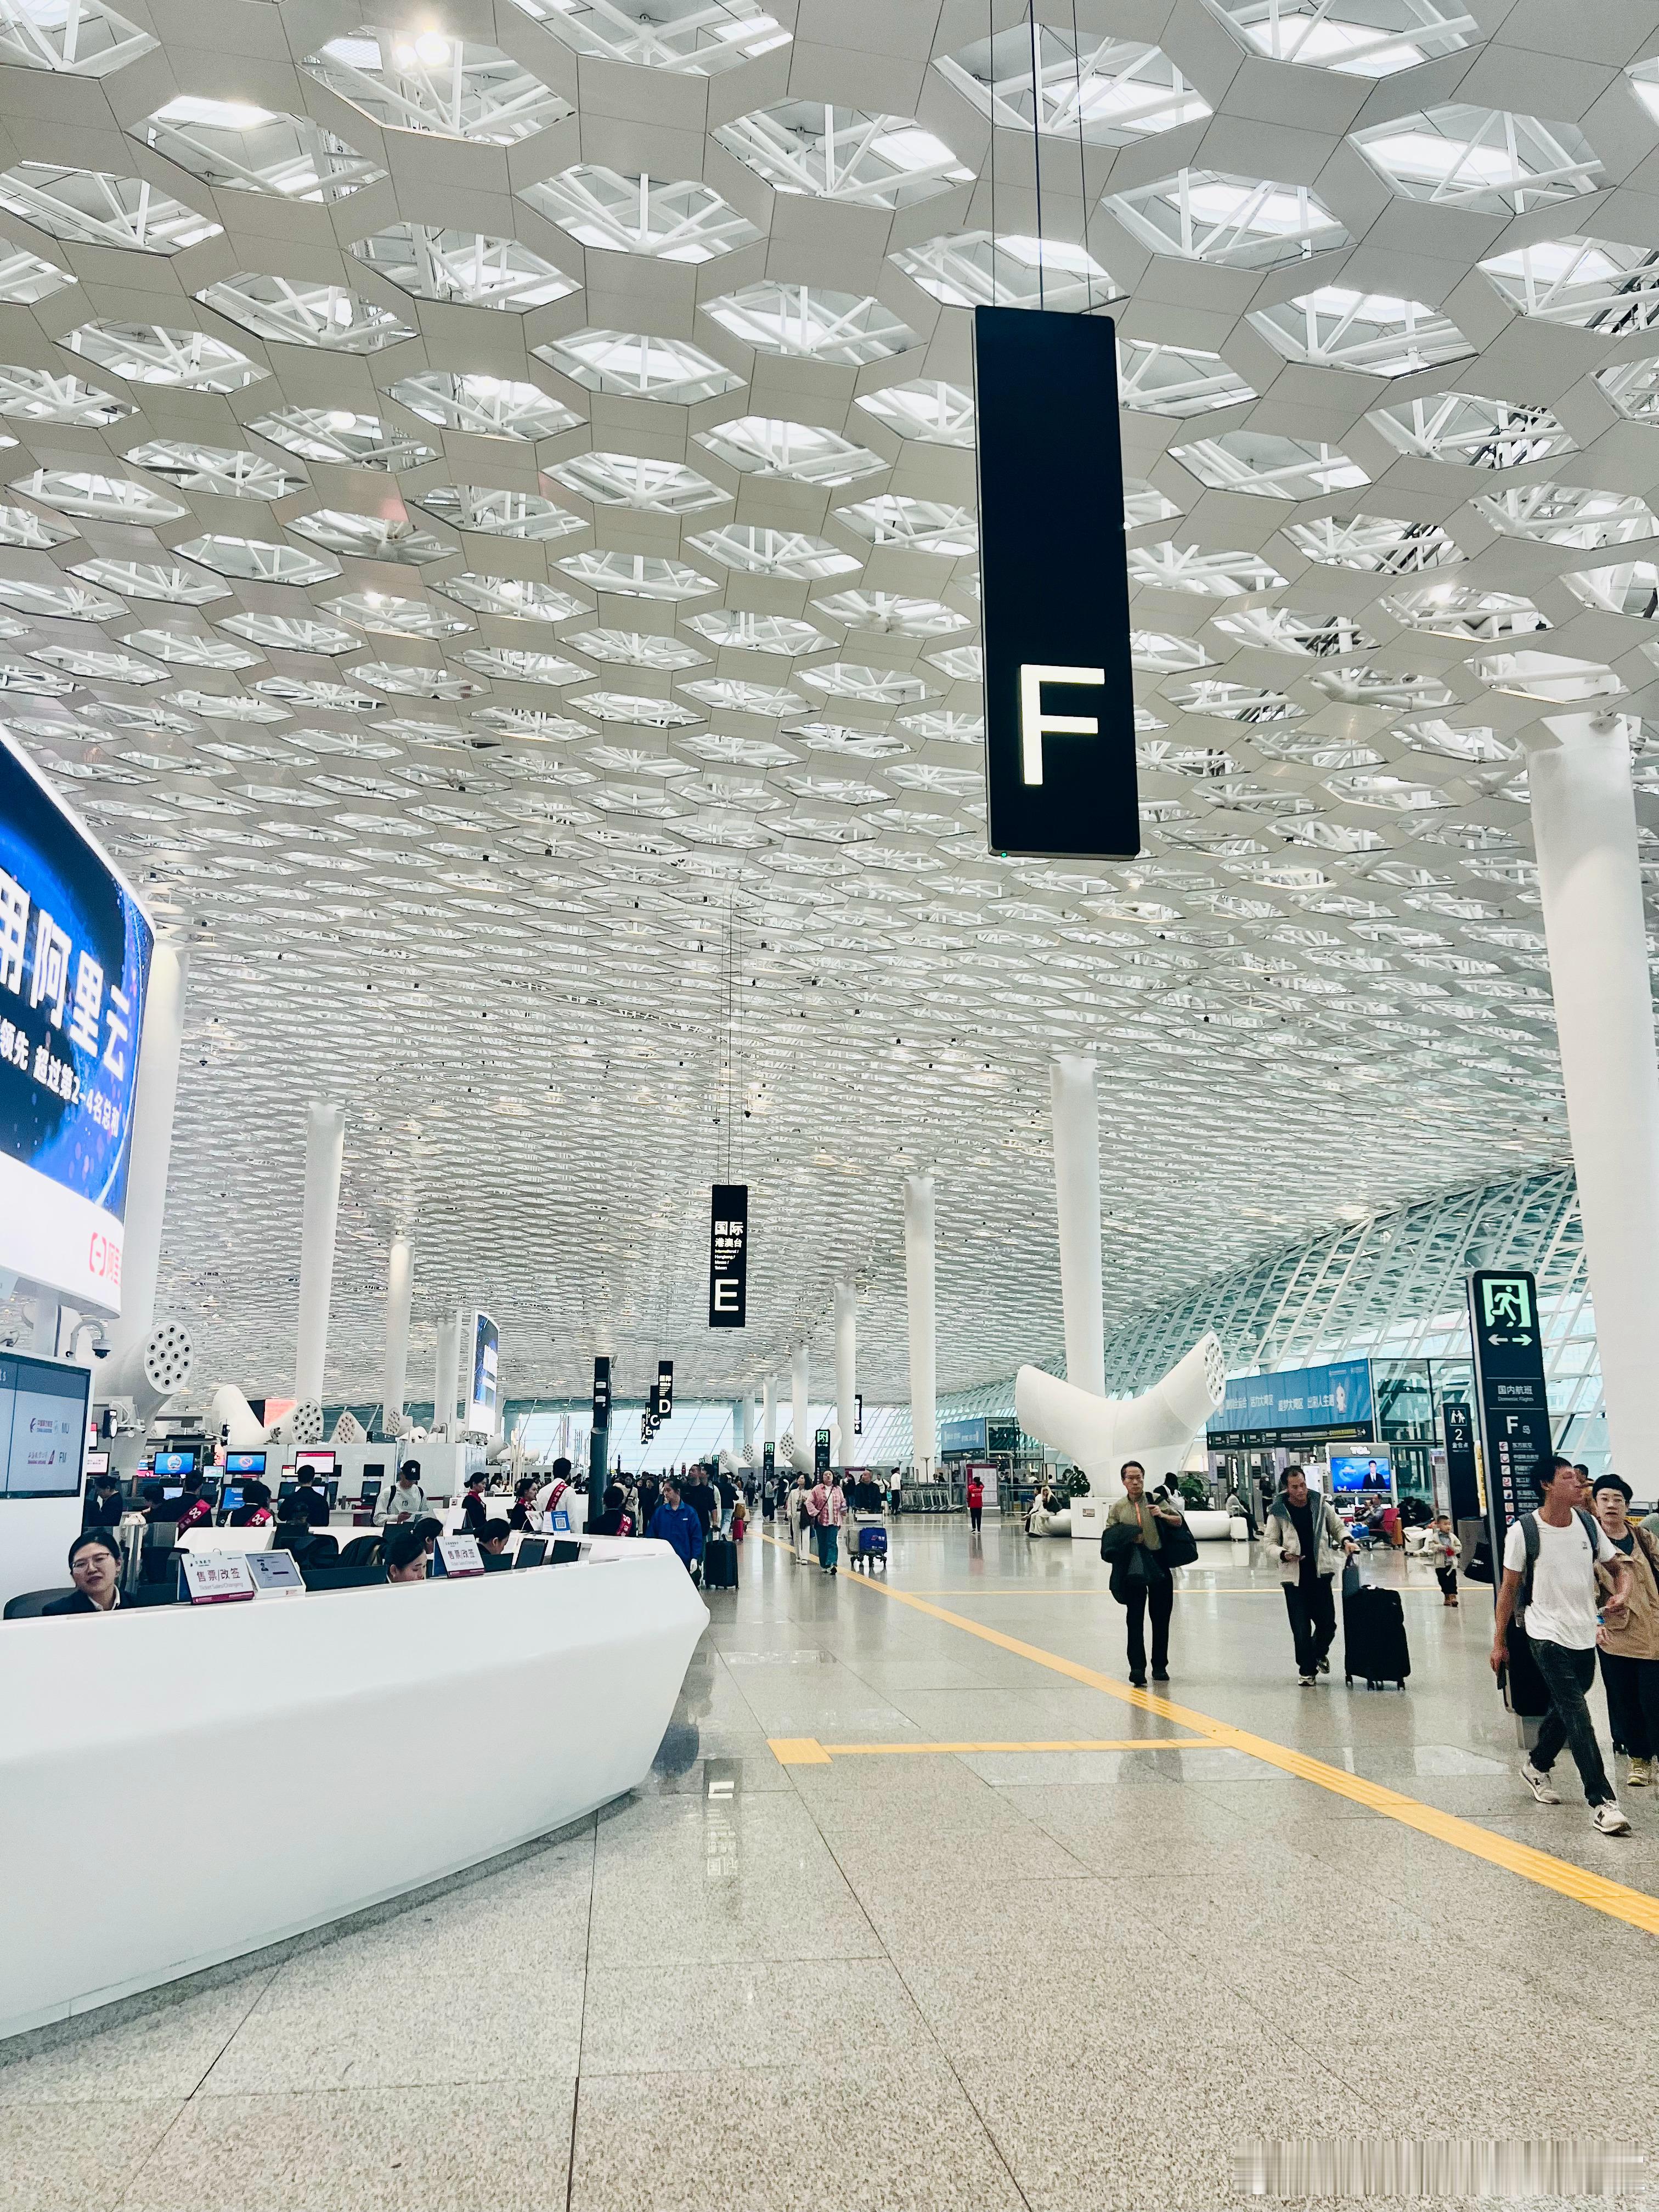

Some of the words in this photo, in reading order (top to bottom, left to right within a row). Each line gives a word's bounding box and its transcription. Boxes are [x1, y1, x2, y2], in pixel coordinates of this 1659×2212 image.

[1020, 664, 1105, 785] F
[0, 867, 130, 1081] 用阿里云
[0, 1015, 29, 1070] 领先
[33, 1045, 120, 1138] 超过第2-4名总和
[714, 1221, 744, 1236] 国际
[715, 1237, 742, 1248] 港澳台
[714, 1279, 739, 1311] E
[1497, 1385, 1533, 1395] 国内航班
[659, 1399, 671, 1413] D
[650, 1414, 659, 1426] C
[1506, 1416, 1519, 1434] F
[1454, 1429, 1463, 1441] 2
[1350, 1446, 1371, 1455] TCL
